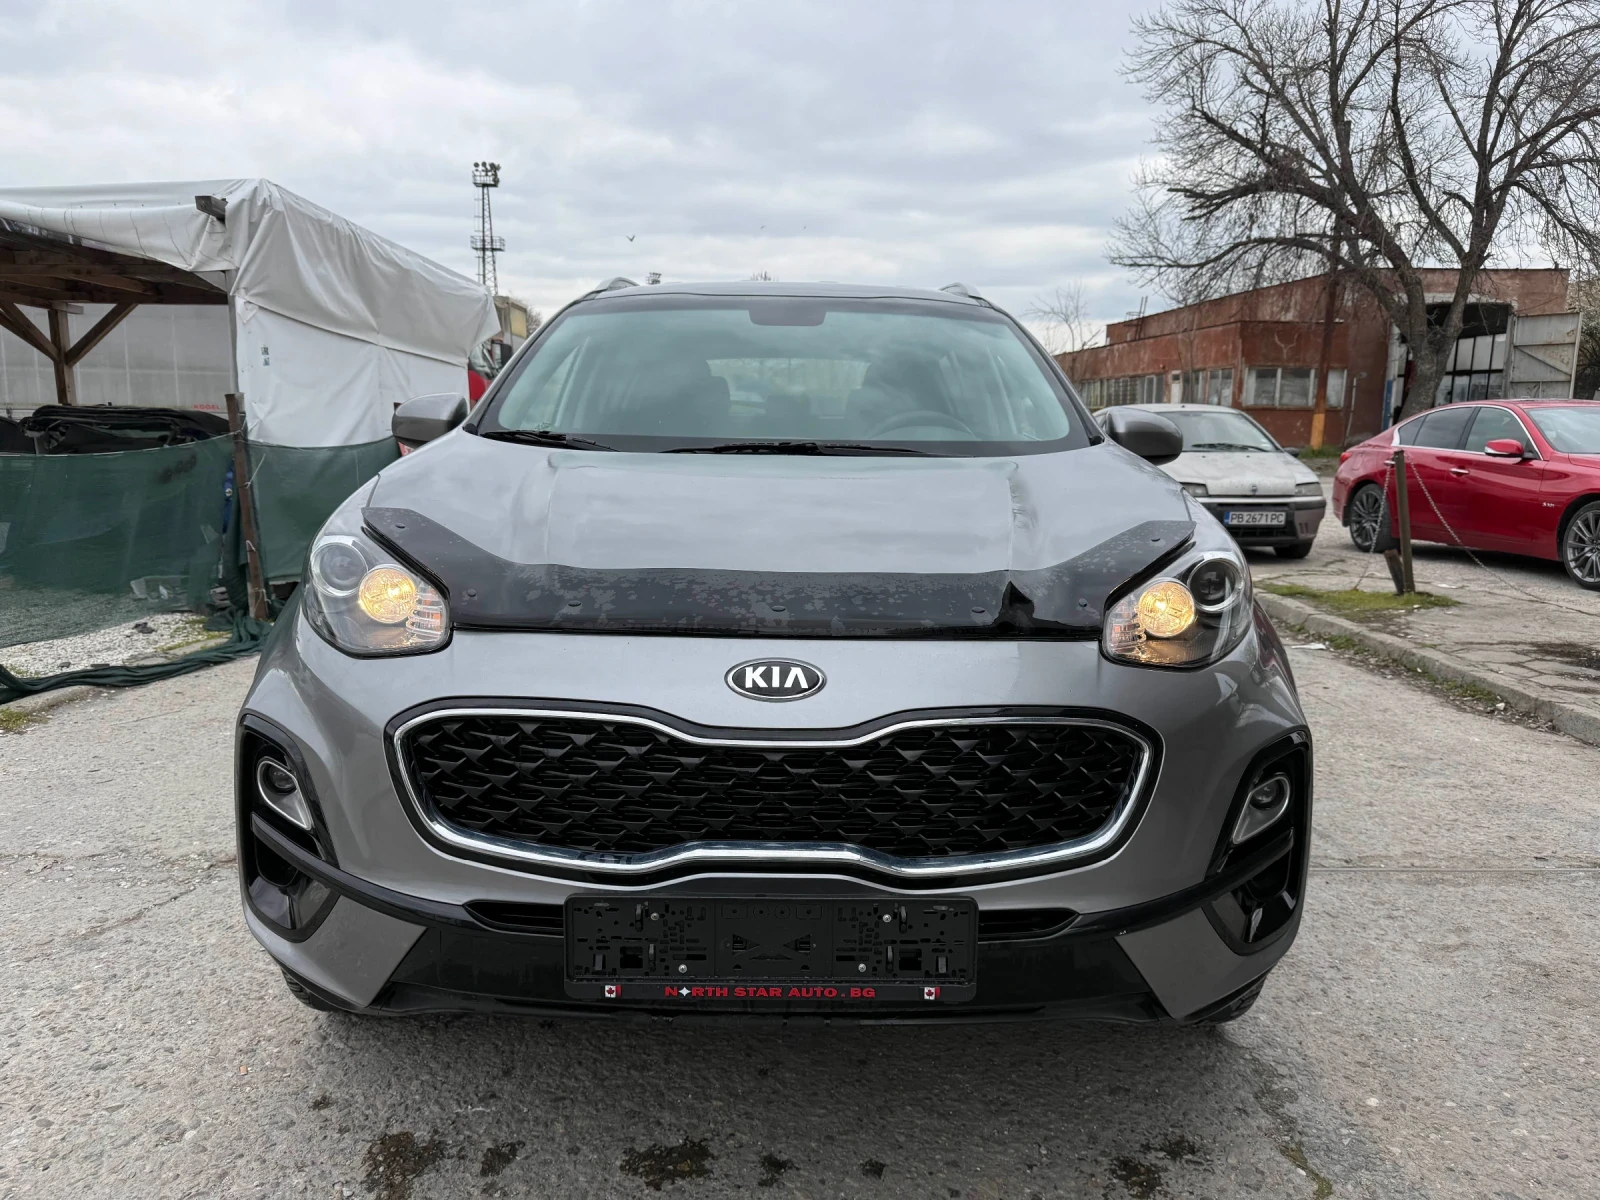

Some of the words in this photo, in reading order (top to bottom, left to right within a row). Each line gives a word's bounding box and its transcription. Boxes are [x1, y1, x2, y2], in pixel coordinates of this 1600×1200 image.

[1245, 513, 1269, 523] 2671
[744, 666, 809, 689] KIA
[734, 986, 782, 998] STAR
